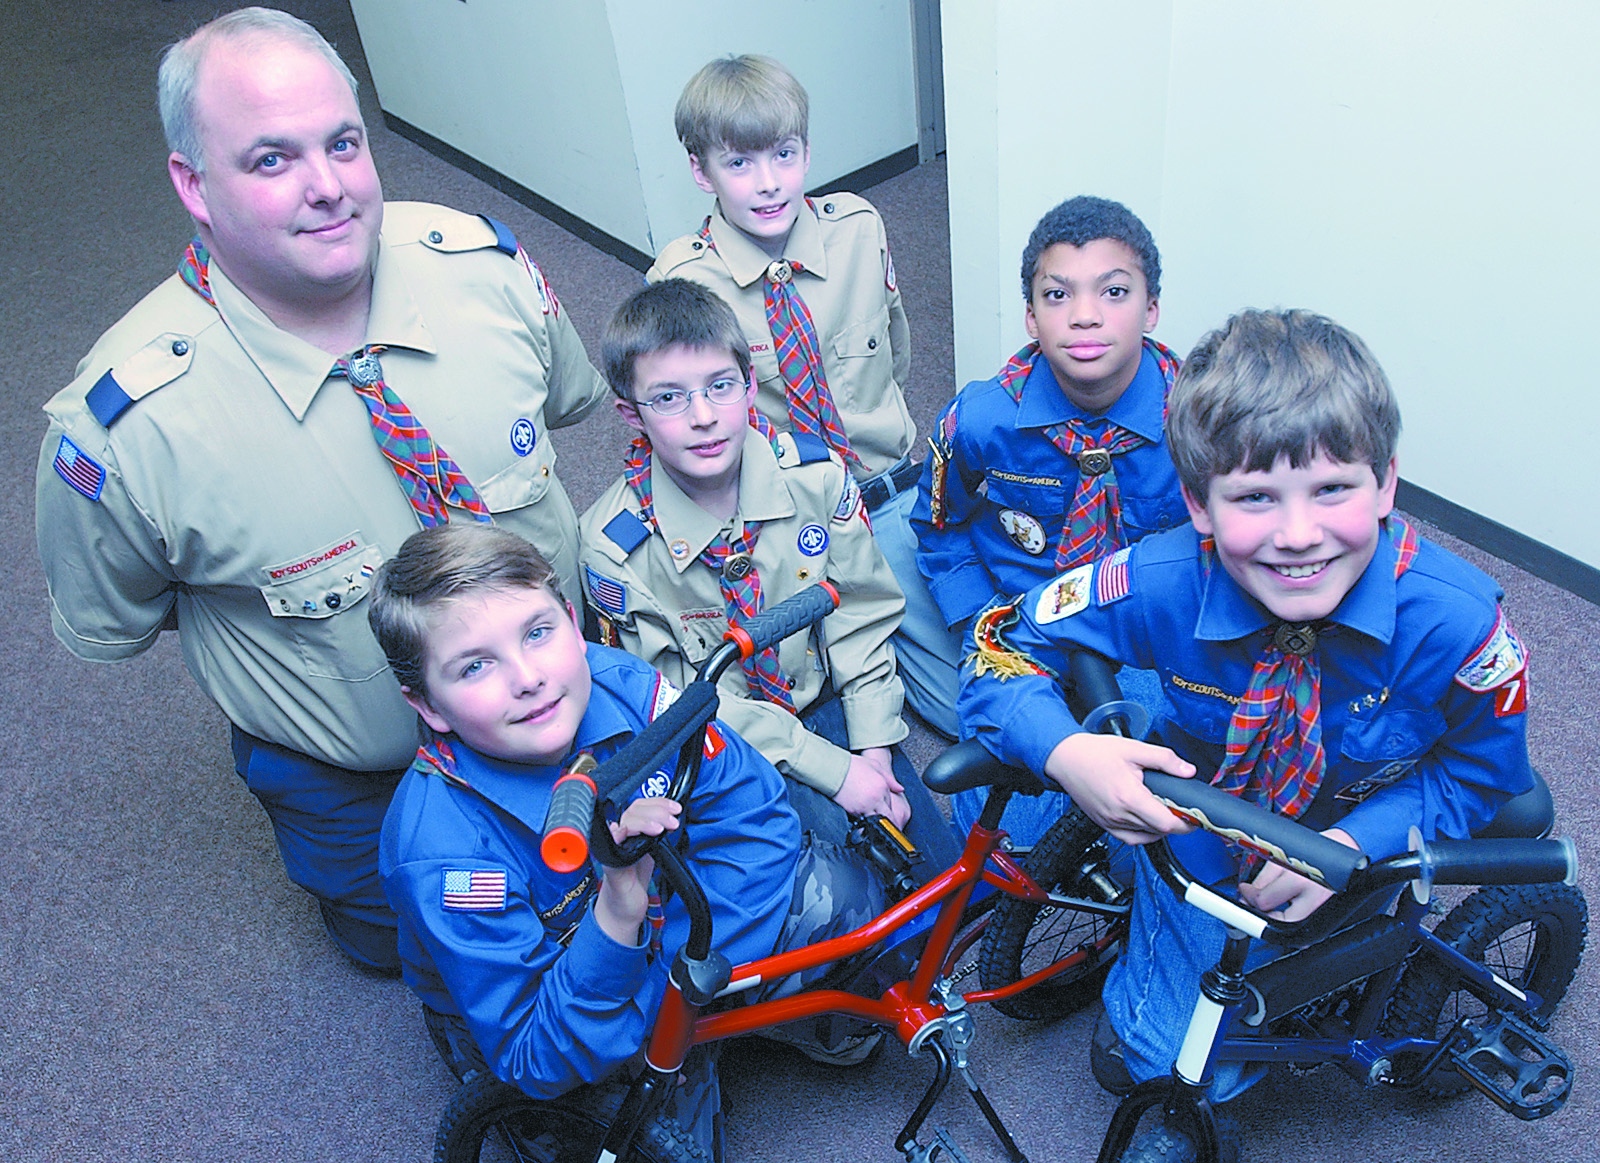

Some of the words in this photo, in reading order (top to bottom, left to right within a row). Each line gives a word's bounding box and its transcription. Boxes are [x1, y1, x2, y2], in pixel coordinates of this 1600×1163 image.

[269, 568, 287, 579] BOY
[286, 556, 318, 575] SCOUTS
[323, 539, 357, 561] AMERICA
[1187, 682, 1222, 699] SCOUTS
[1501, 679, 1521, 712] 7
